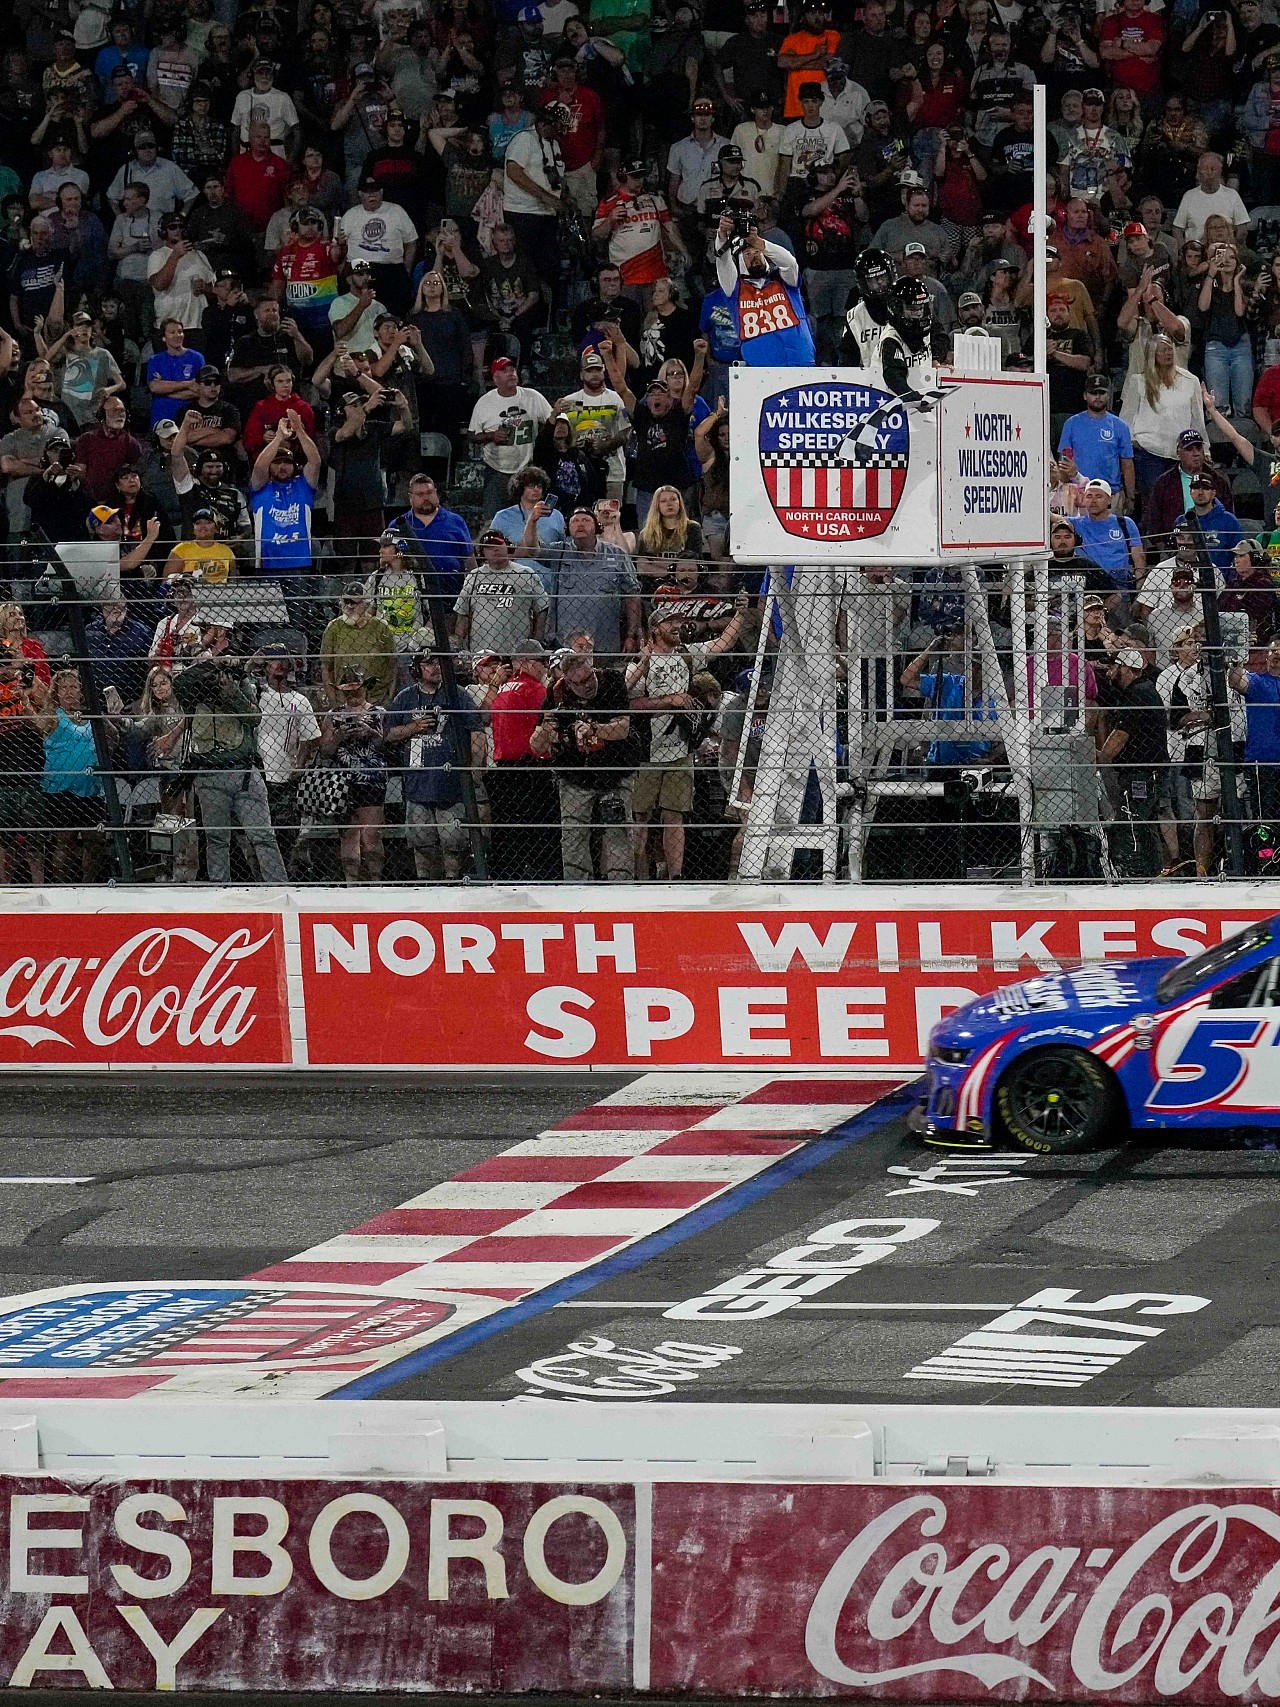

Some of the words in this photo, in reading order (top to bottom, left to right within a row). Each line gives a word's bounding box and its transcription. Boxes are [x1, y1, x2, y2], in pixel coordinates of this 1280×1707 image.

[797, 138, 826, 147] CAMEL
[744, 304, 794, 339] 838
[798, 391, 870, 407] NORTH
[766, 412, 903, 429] WILKESBO
[974, 413, 1012, 441] NORTH
[778, 433, 892, 450] SPEEDY
[959, 449, 1028, 478] WILKESBORO
[963, 486, 1024, 514] SPEEDWAY
[786, 512, 823, 521] NORTH
[825, 512, 882, 521] CAROLINA
[816, 523, 851, 536] USA
[477, 584, 514, 595] BELL
[313, 919, 637, 977] NORTH
[0, 928, 275, 1047] ca-Cola
[1145, 1017, 1270, 1111] 5
[662, 1217, 942, 1321] GEICO
[0, 1308, 77, 1342] ORTH
[0, 1292, 173, 1363] WILKESBORO
[51, 1297, 218, 1358] SPEEDWAY
[984, 1287, 1212, 1337] 75
[361, 1319, 431, 1338] USA
[9, 1492, 628, 1606] ESBORO
[7, 1605, 226, 1691] AY
